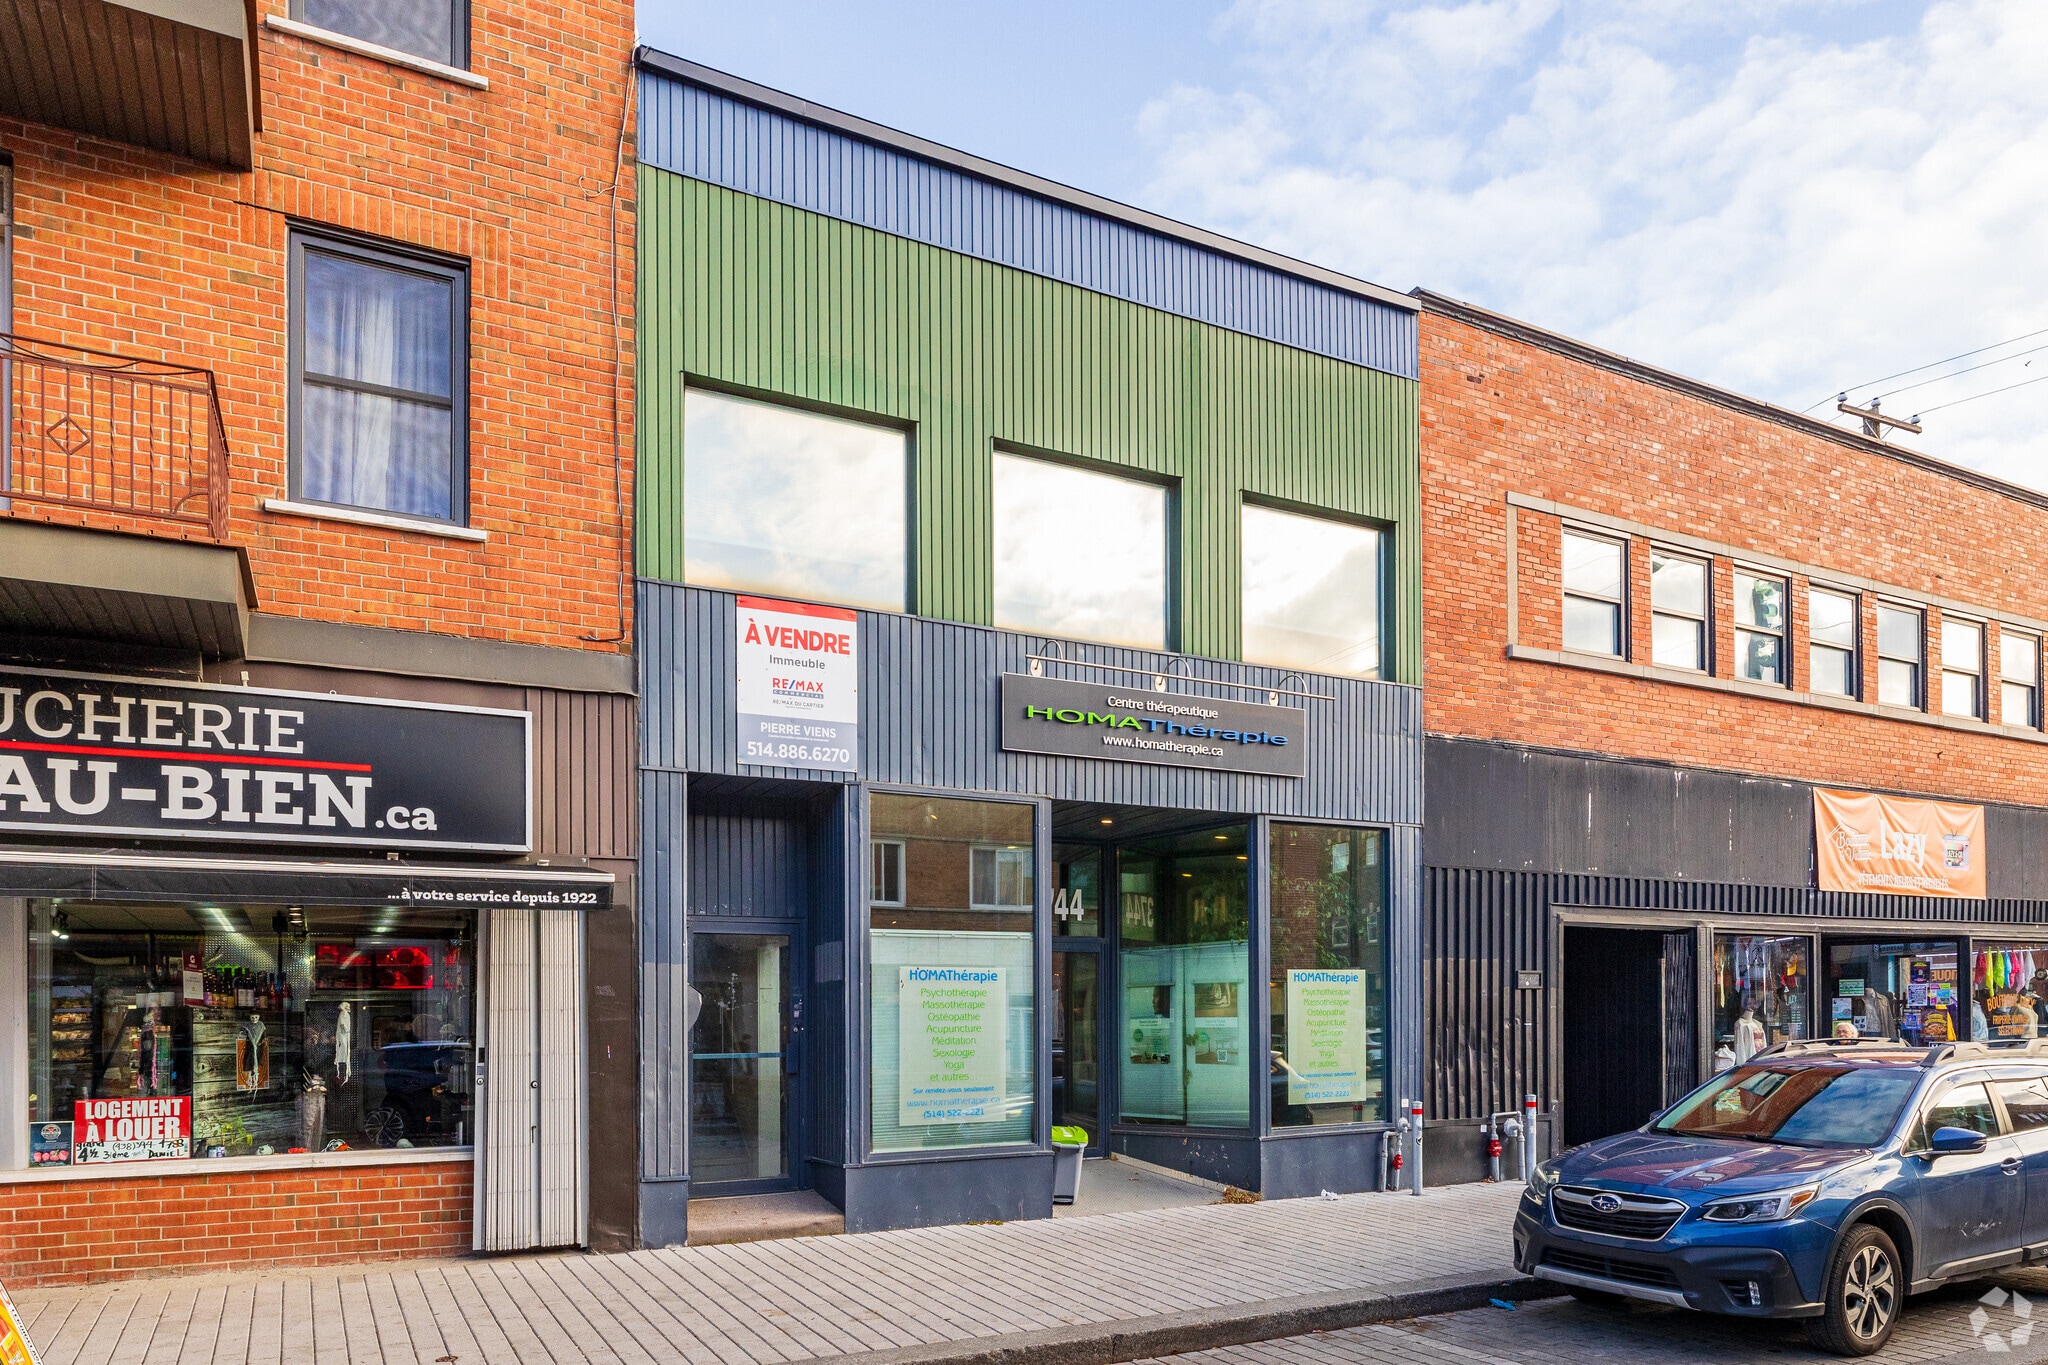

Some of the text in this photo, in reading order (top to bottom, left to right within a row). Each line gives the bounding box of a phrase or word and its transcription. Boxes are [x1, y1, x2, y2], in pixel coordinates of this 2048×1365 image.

[744, 617, 851, 656] À VENDRE
[769, 654, 826, 669] Immeuble
[772, 677, 824, 693] RE/MAX
[1107, 695, 1218, 720] Centre thérapeutique
[761, 722, 800, 735] PIERRE
[803, 725, 837, 739] VIENS
[1026, 704, 1289, 746] HOMAThérapie
[747, 741, 850, 763] 514.886.6270
[1103, 735, 1223, 757] www.homatherapie.ca
[1880, 819, 1926, 870] Lazy
[413, 891, 454, 901] votre
[456, 890, 510, 902] service
[512, 891, 560, 906] depuis
[562, 892, 598, 904] 1922
[1052, 888, 1084, 921] 44
[909, 969, 998, 984] HOMAThérapie
[1293, 972, 1359, 985] HOMAThérapie
[920, 988, 987, 999] Psychothérapie
[922, 1000, 985, 1011] Massothérapie
[927, 1012, 981, 1023] Ostéopathie
[926, 1024, 982, 1035] Acupuncture
[931, 1036, 977, 1046] Méditation
[933, 1049, 975, 1059] Sexologie
[944, 1061, 965, 1071] Yoga
[930, 1073, 939, 1082] et
[85, 1098, 183, 1120] LOGEMENT
[86, 1121, 100, 1142] À
[106, 1117, 180, 1142] LOUER
